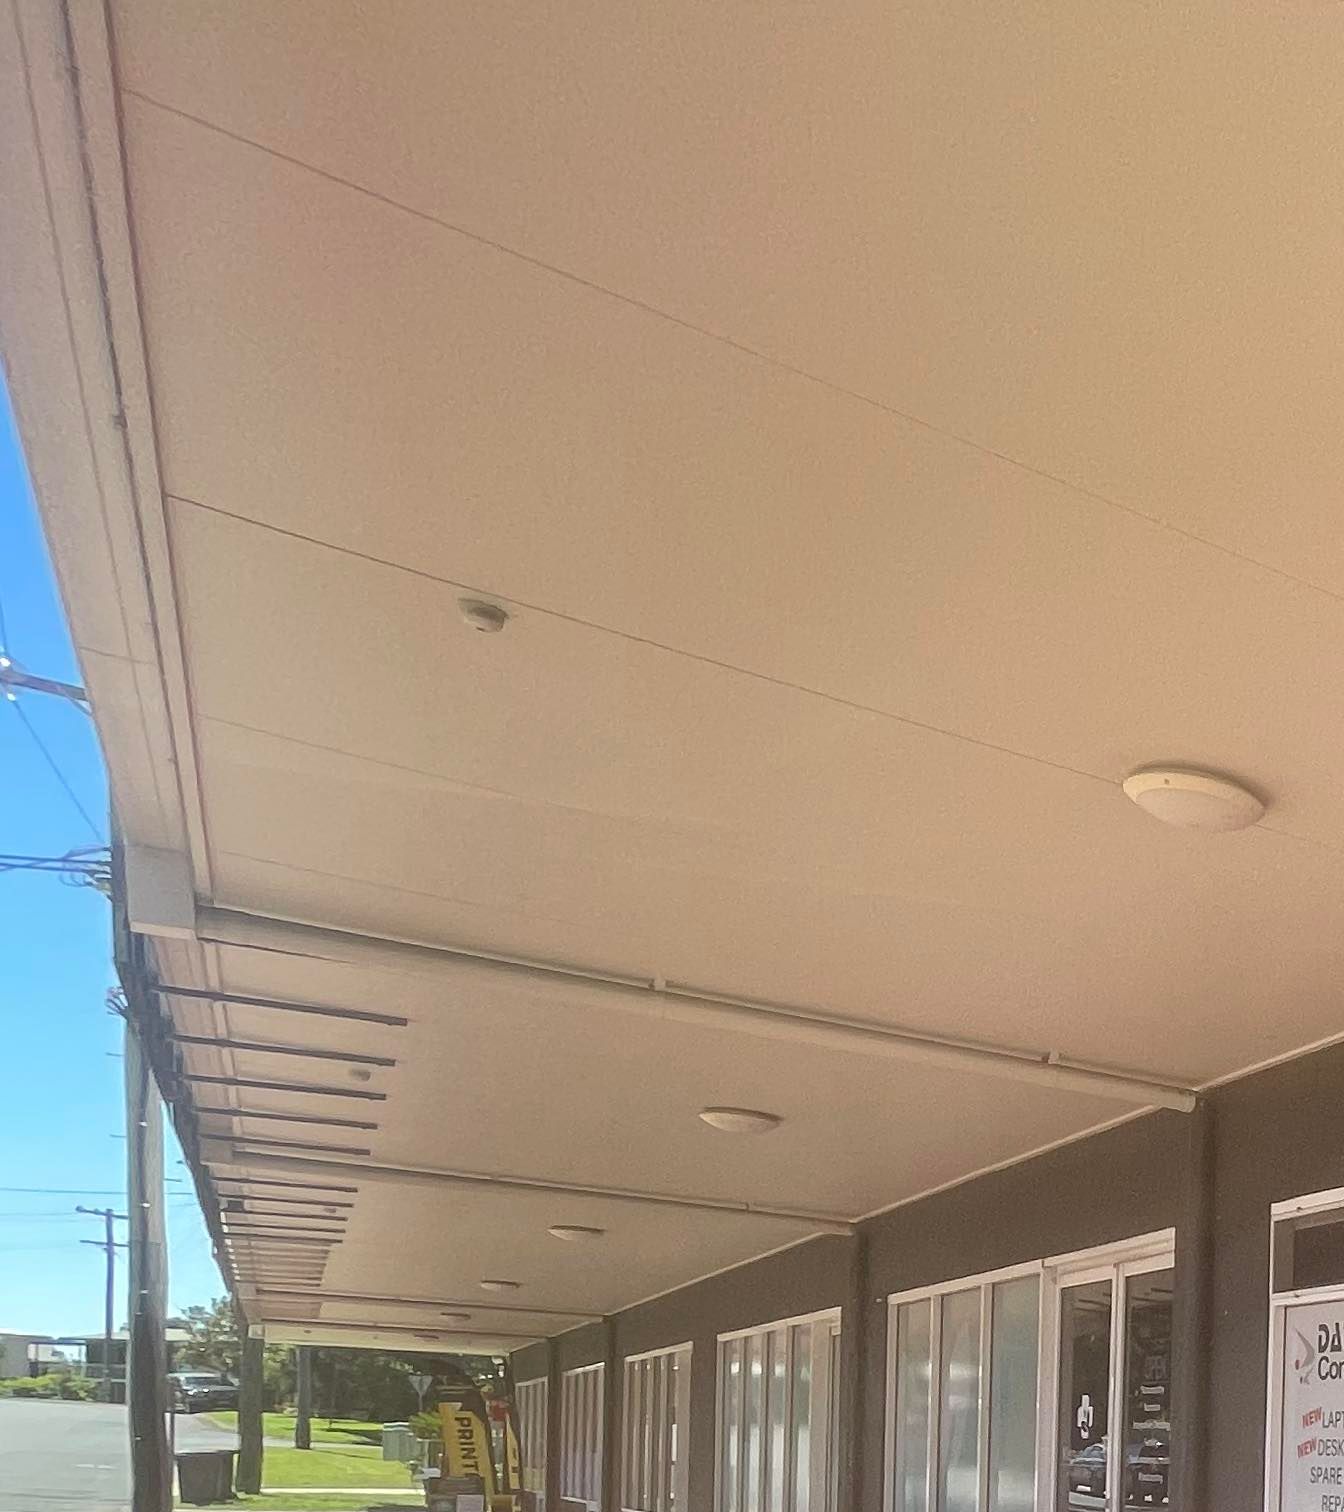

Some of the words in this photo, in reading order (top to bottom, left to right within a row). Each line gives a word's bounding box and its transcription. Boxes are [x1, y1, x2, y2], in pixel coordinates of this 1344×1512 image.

[1302, 1407, 1322, 1428] NEW
[1297, 1437, 1317, 1458] NEW
[1310, 1466, 1343, 1485] SPARE
